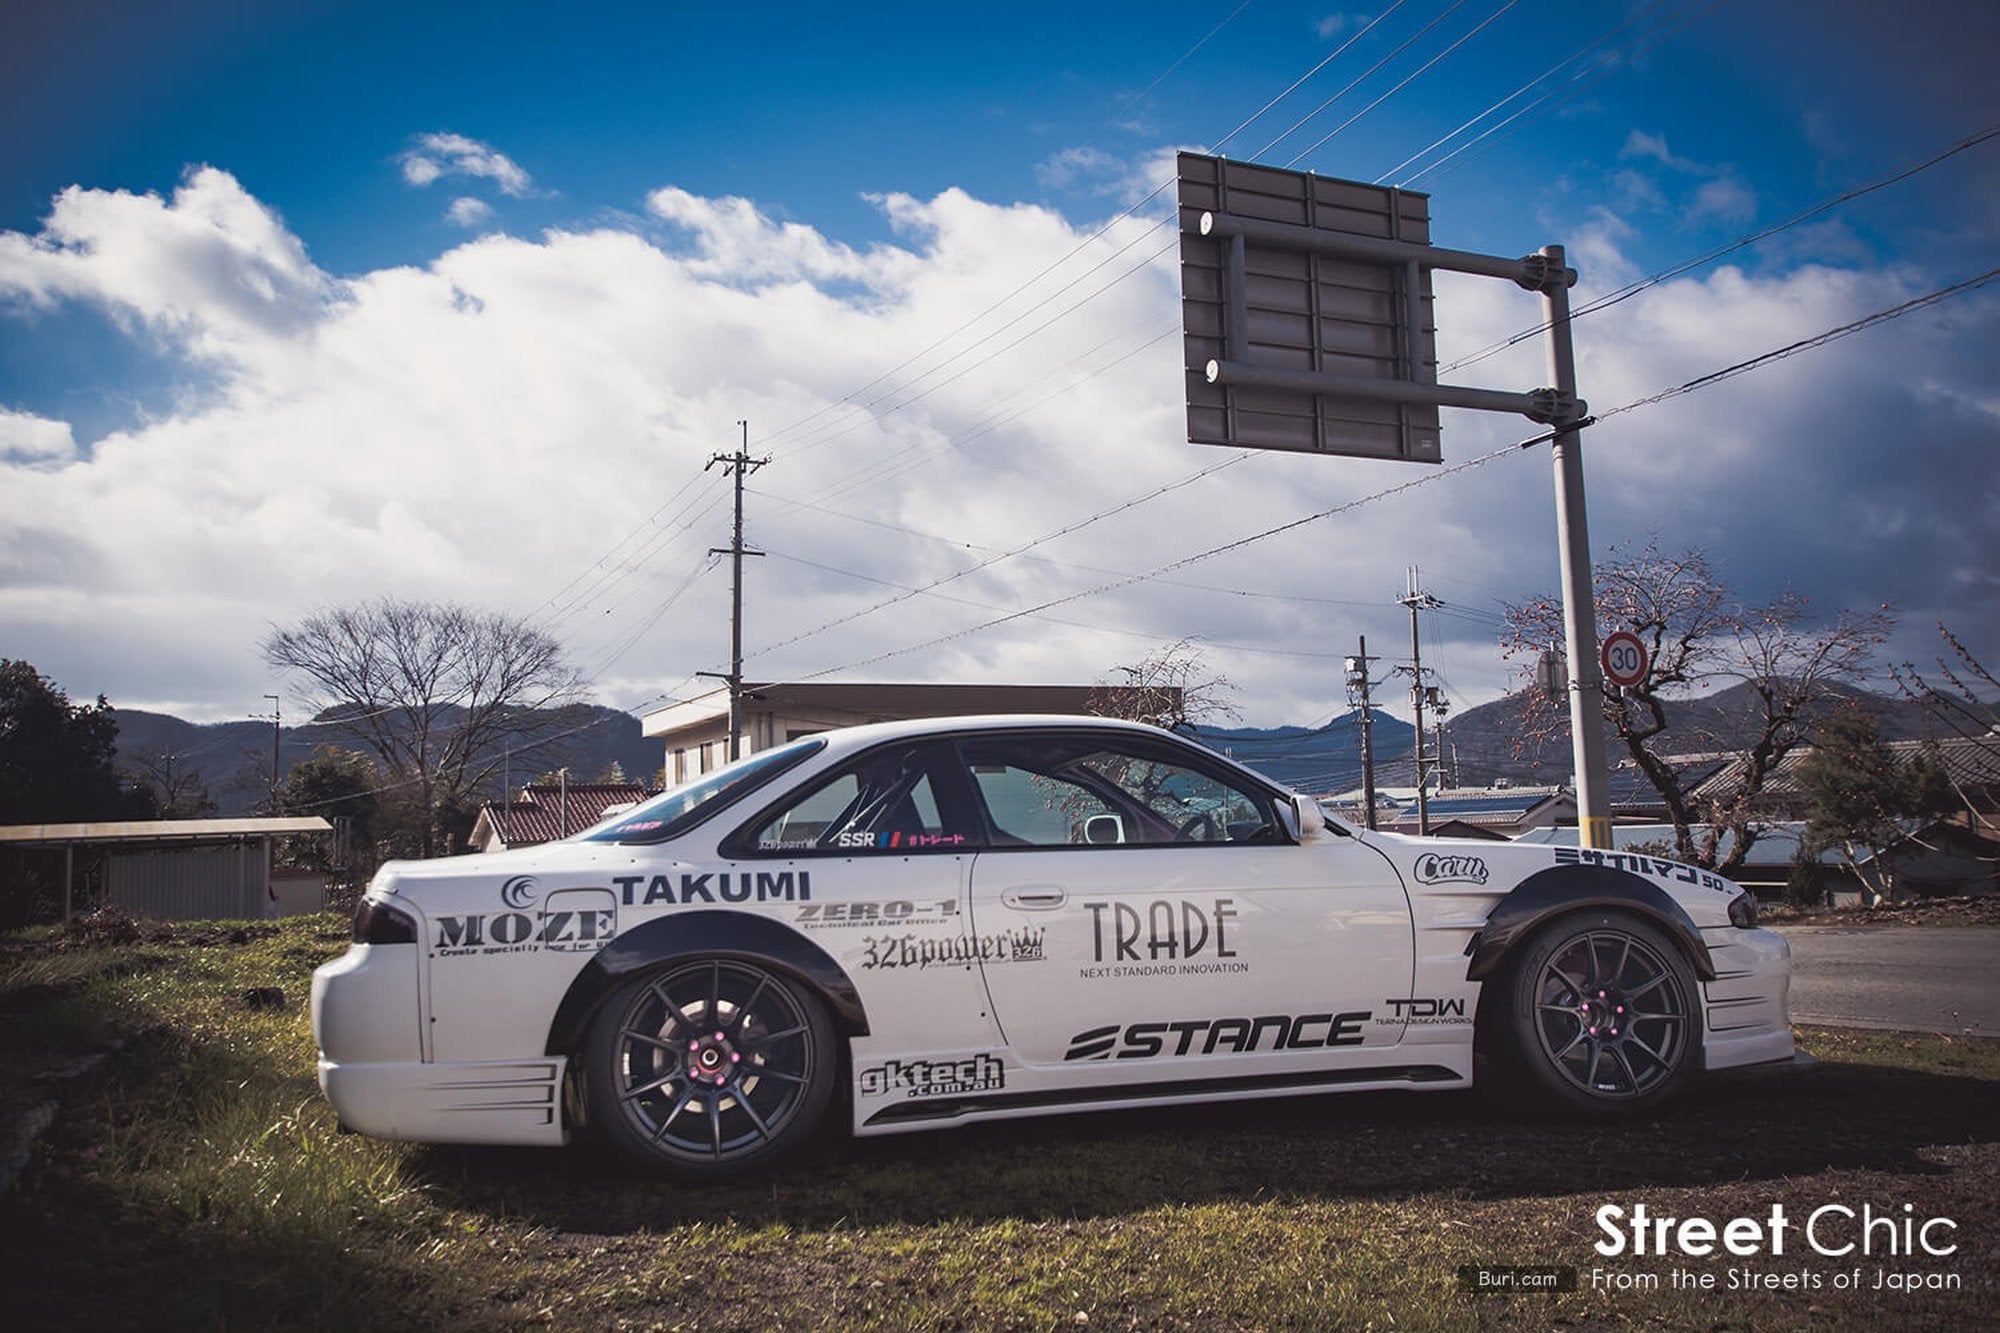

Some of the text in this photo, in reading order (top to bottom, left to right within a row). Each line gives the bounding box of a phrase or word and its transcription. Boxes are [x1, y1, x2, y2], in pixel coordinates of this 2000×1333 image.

[1611, 646, 1638, 671] 30
[838, 831, 875, 848] SSR
[1554, 847, 1698, 885] ミサイルマン
[612, 871, 811, 906] TAKUMI
[434, 910, 614, 947] MOZE
[795, 900, 957, 922] ZERO-1
[1083, 899, 1238, 962] TRADE
[1080, 963, 1249, 978] NEXT STANDARD INNOVATION
[1386, 998, 1465, 1016] TDW
[1116, 1010, 1373, 1059] STANCE
[860, 1053, 1005, 1096] gktech
